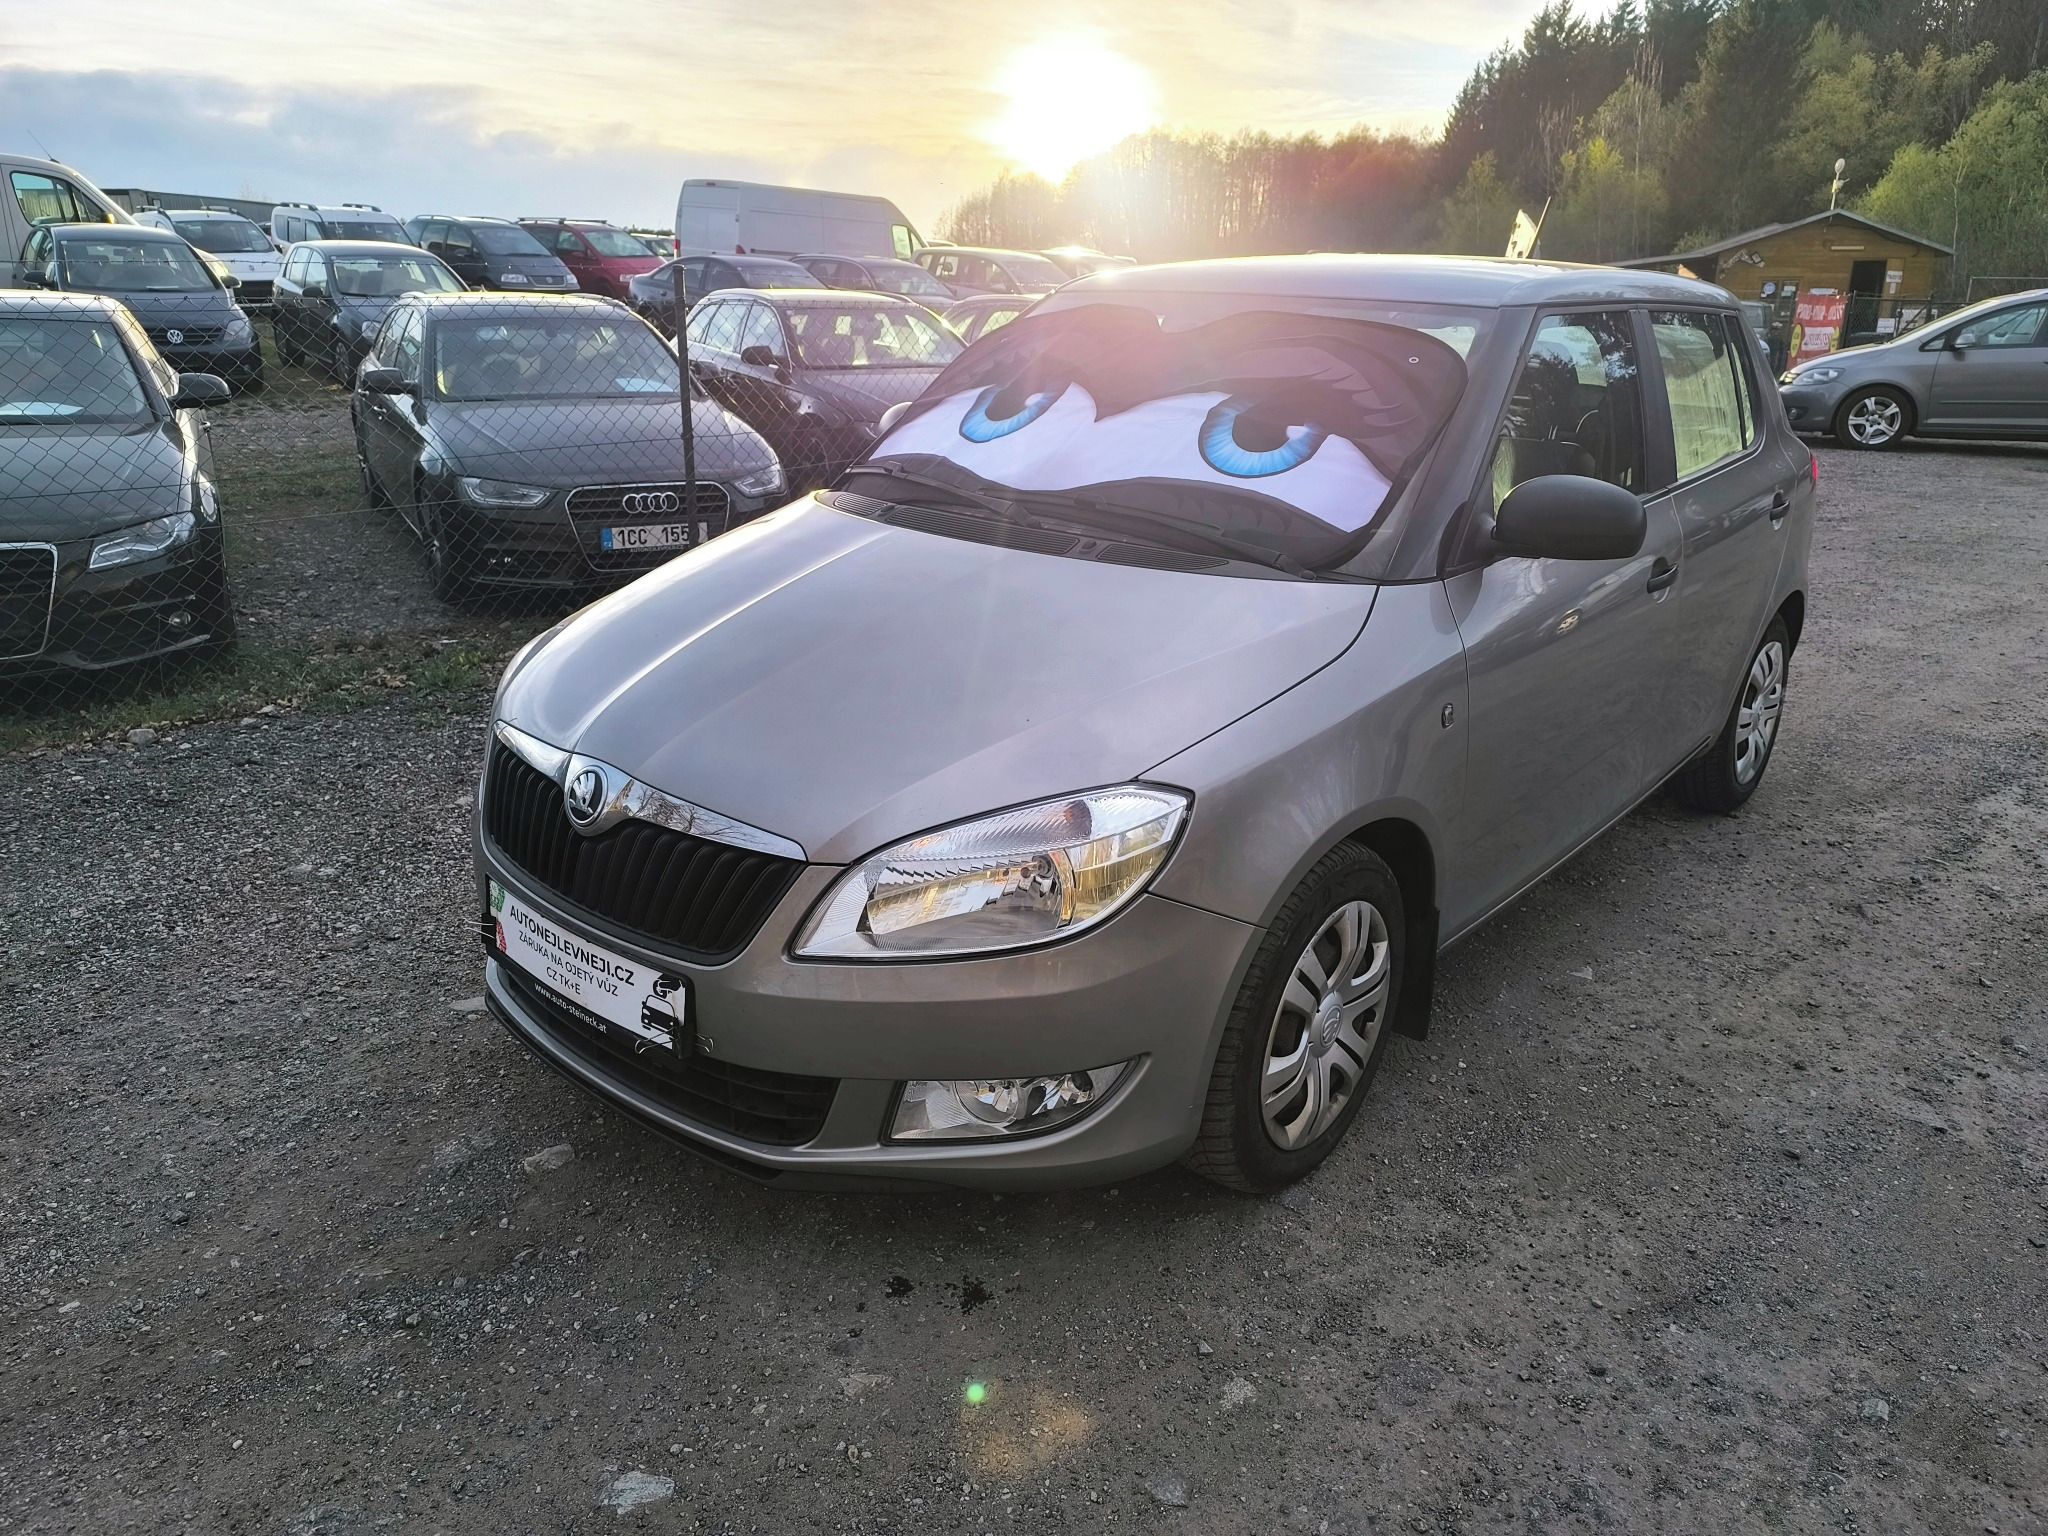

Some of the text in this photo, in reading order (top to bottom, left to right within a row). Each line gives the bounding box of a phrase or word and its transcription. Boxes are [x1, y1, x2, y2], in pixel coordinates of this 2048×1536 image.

[618, 526, 700, 547] 1CC 155
[510, 905, 635, 987] AUTONEJLEVNEJI.CZ
[519, 930, 619, 997] ZÁRUKA NA OJETÝ VŮZ
[546, 966, 581, 995] CZ TK+E
[534, 982, 607, 1034] www.auto-steineck.at
